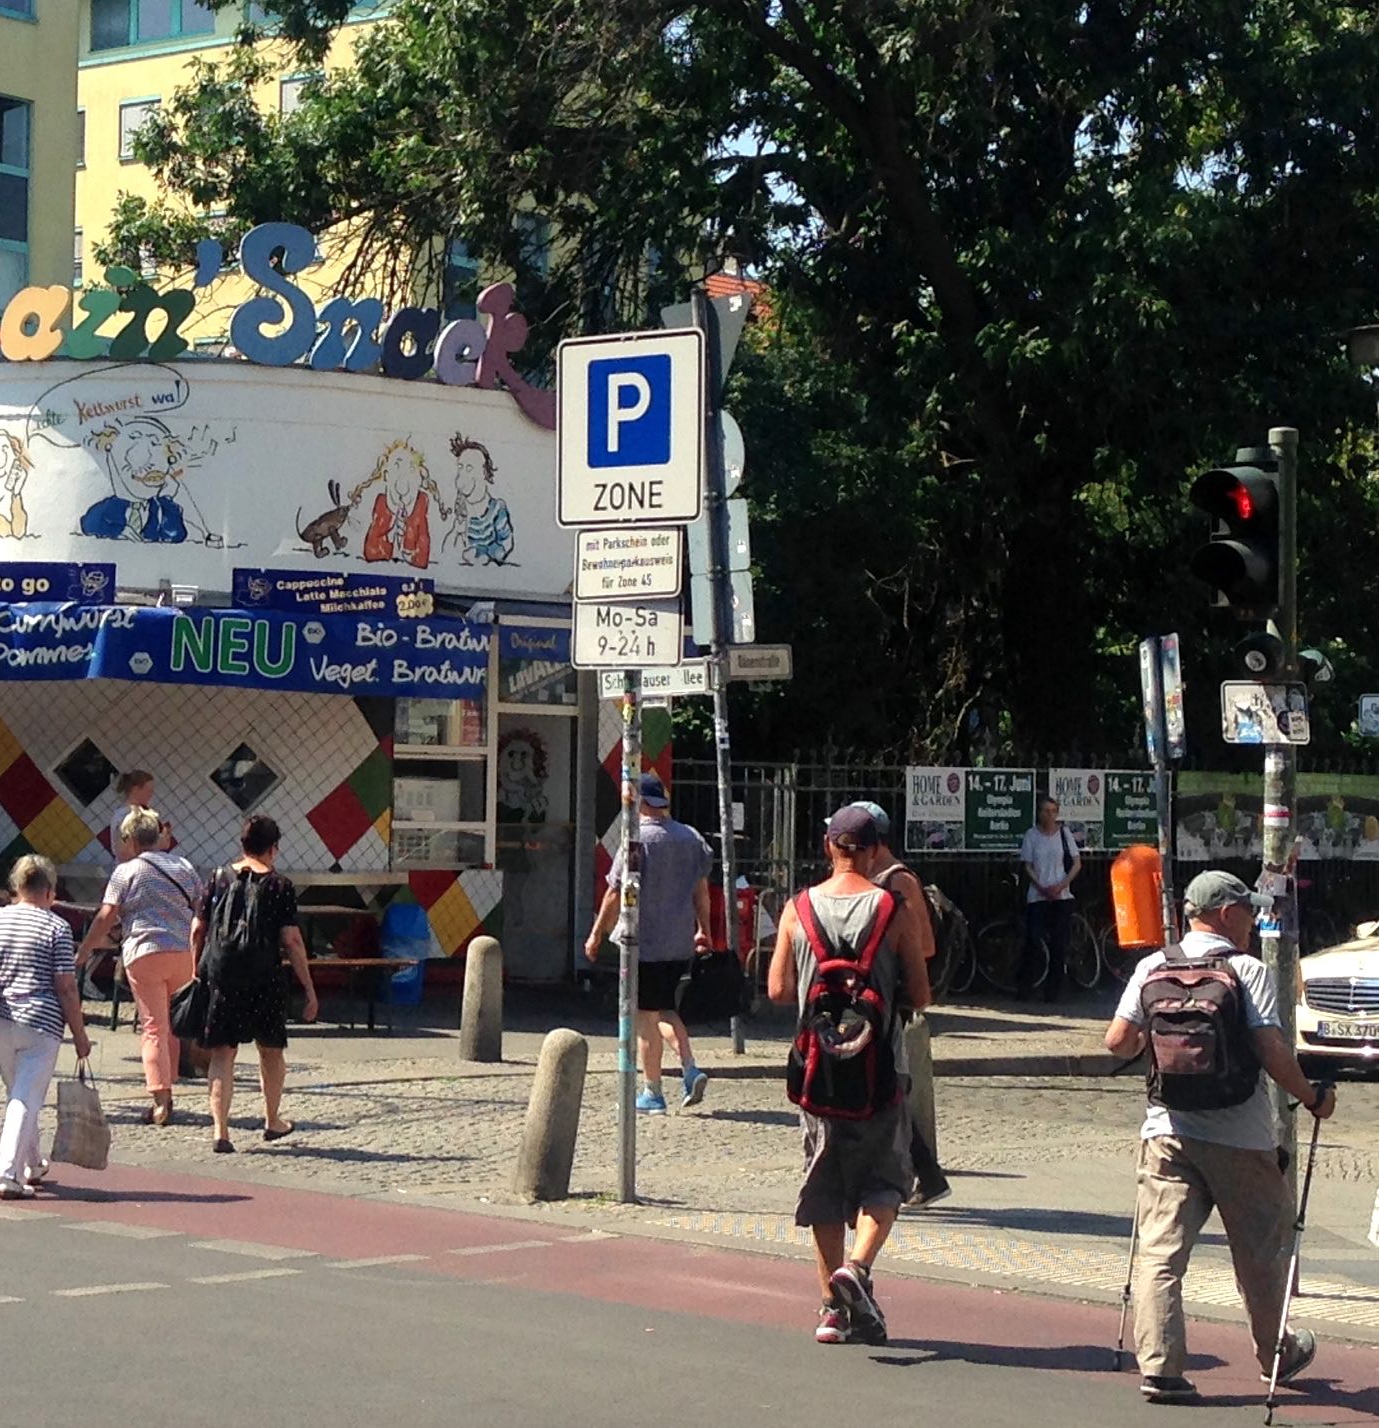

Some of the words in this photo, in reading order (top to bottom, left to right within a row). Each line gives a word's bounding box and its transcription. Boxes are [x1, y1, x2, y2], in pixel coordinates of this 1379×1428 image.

[607, 371, 651, 453] P
[593, 480, 663, 512] ZONE
[586, 539, 600, 551] mit
[603, 536, 648, 550] Parkschein
[651, 534, 670, 547] oder
[22, 577, 50, 594] go
[601, 576, 613, 589] für
[618, 576, 638, 589] Zone
[641, 573, 652, 586] 45
[596, 606, 658, 627] Mo-Sa
[355, 622, 397, 647] Bio
[171, 616, 296, 678] NEU
[597, 635, 640, 657] 9-24
[647, 635, 656, 656] h
[310, 655, 379, 684] Veget.
[912, 775, 942, 794] HOME
